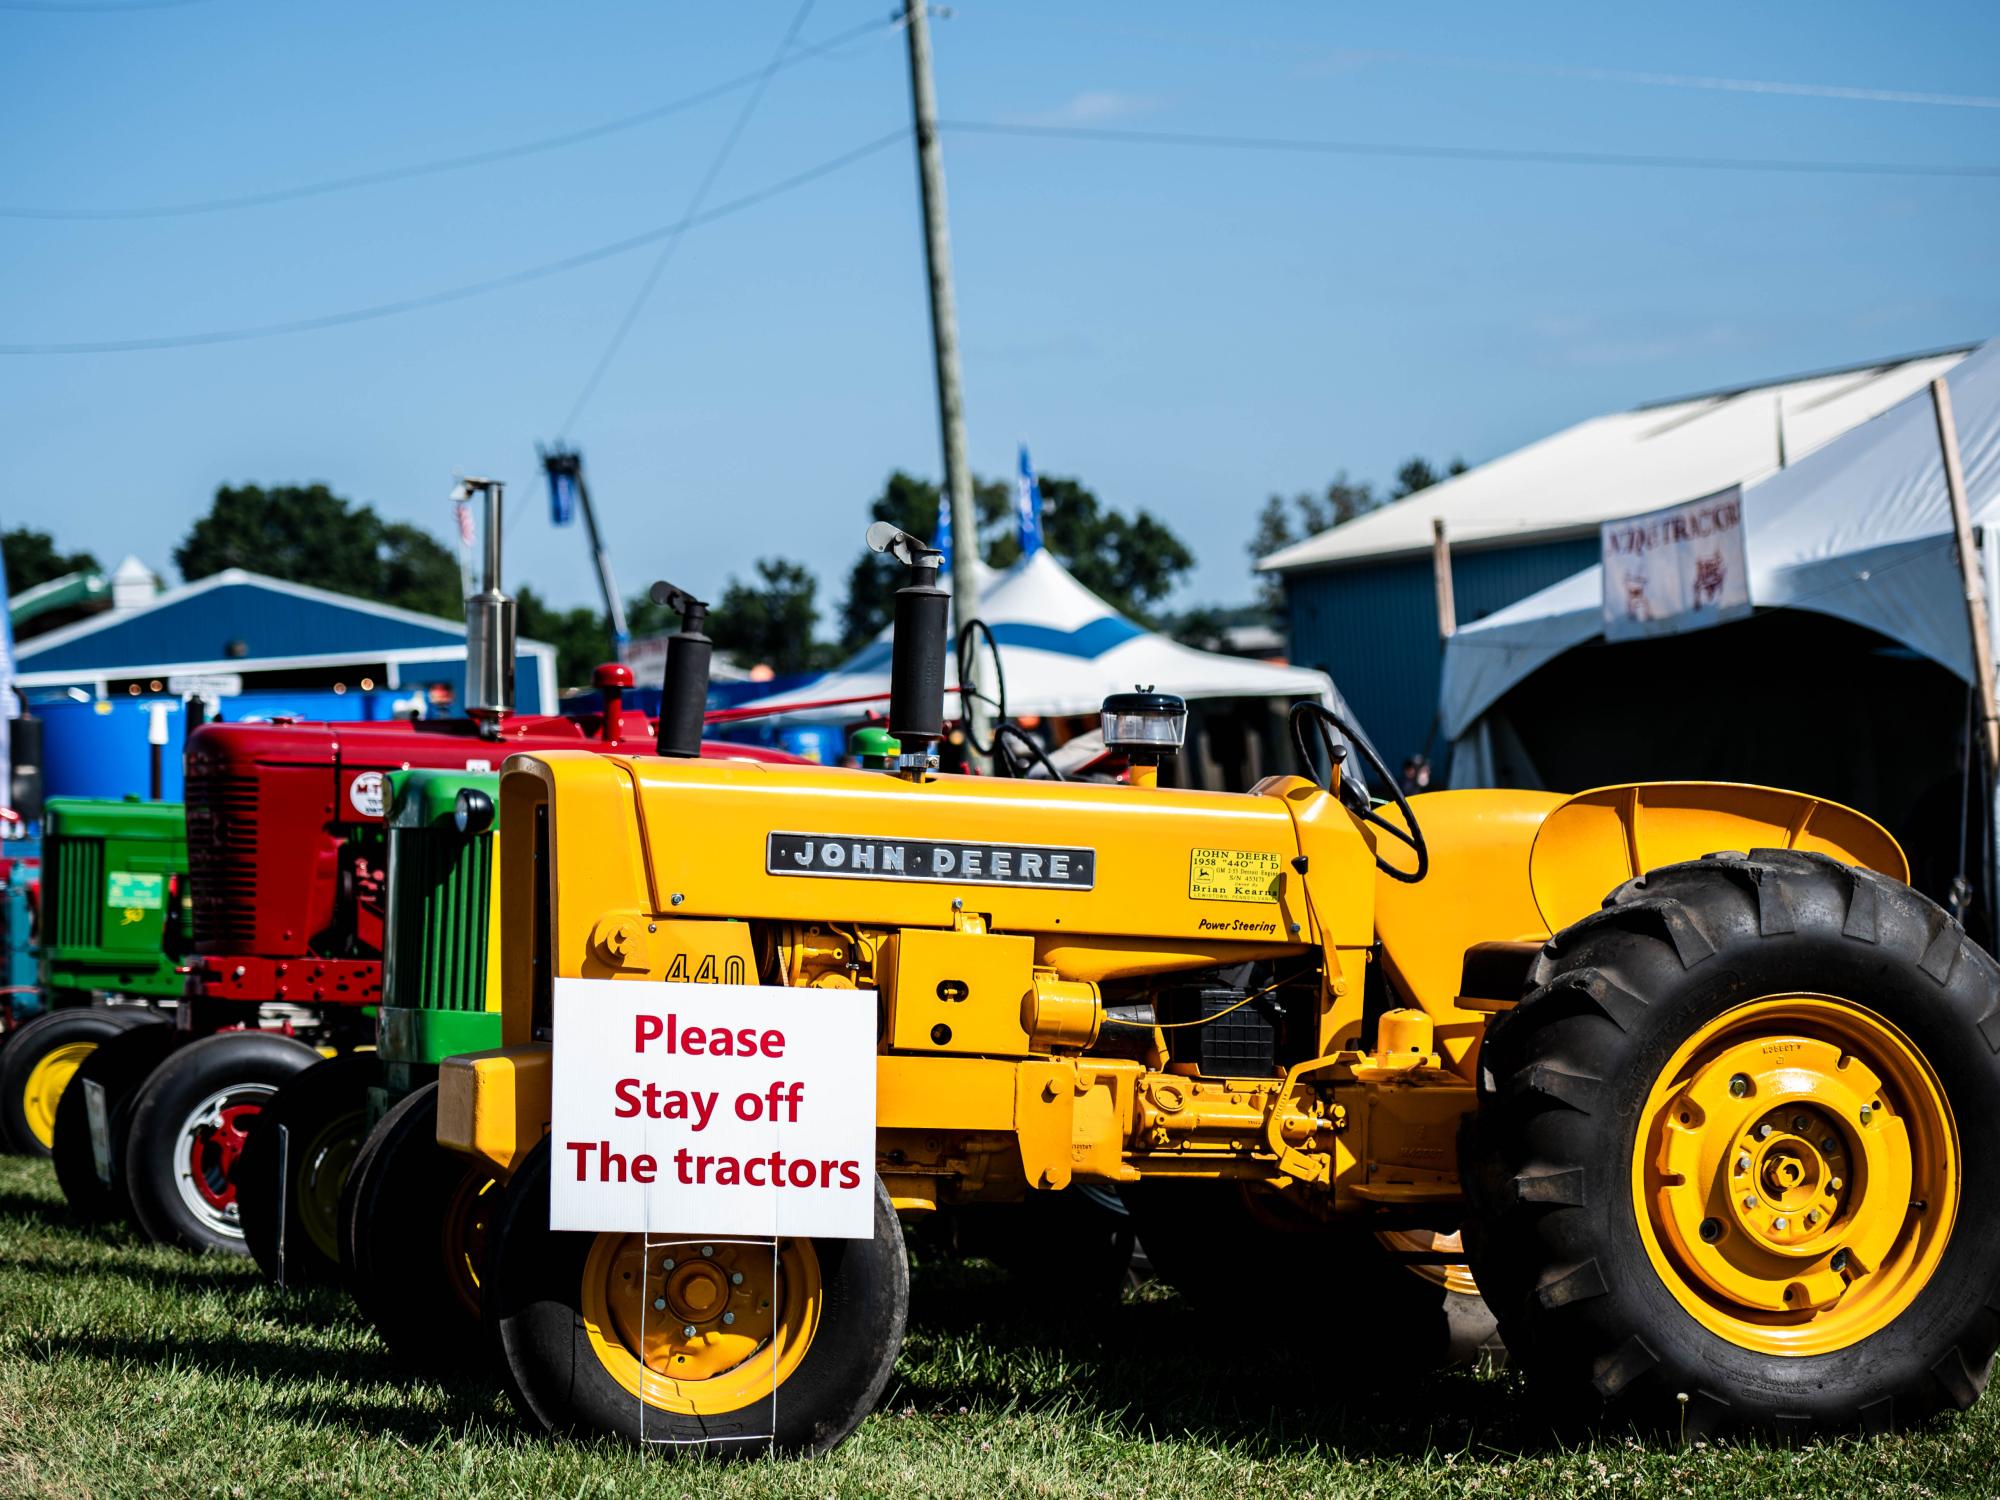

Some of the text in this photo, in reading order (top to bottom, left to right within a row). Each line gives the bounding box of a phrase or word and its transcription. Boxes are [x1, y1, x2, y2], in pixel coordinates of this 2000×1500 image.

[793, 841, 1071, 879] JOHN DEERE
[1193, 858, 1217, 866] 1958
[1196, 850, 1277, 862] JOHN DEERE
[1192, 885, 1227, 894] Brian
[1198, 918, 1277, 935] Power Steering
[665, 954, 745, 985] 440
[635, 1013, 786, 1059] Please
[614, 1077, 805, 1132] Stay off
[566, 1140, 861, 1190] The tractors
